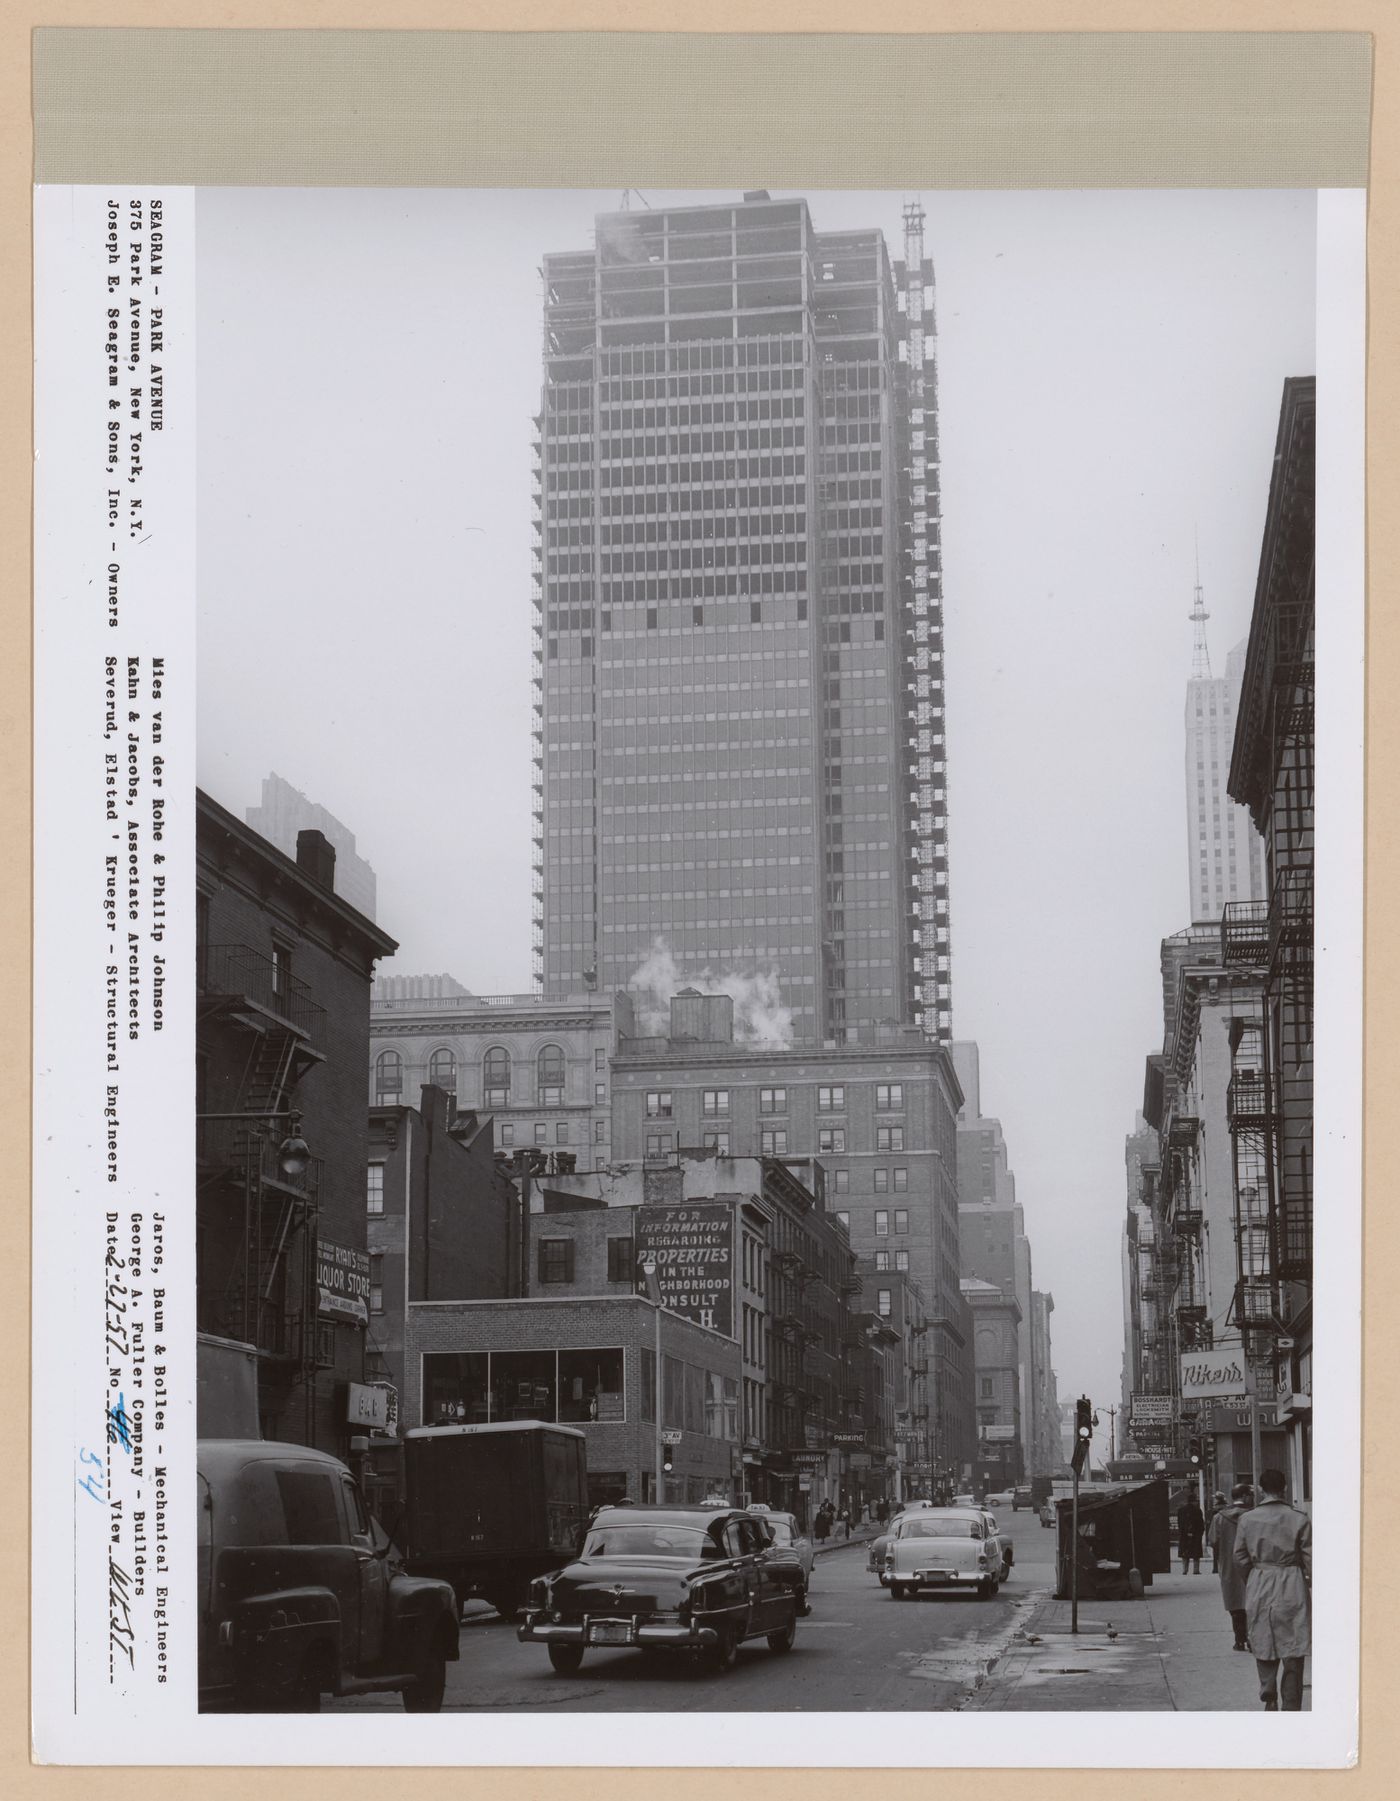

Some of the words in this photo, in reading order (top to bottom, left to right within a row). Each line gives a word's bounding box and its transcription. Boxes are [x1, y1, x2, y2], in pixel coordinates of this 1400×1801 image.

[105, 199, 121, 265] Joseph
[129, 199, 143, 231] 375
[149, 199, 164, 276] SEAGRAM
[107, 275, 121, 294] E.
[129, 242, 143, 287] Park
[104, 308, 120, 387] Seagram
[127, 297, 142, 372] Avenue,
[150, 308, 164, 353] PARK
[108, 398, 121, 410] &
[130, 387, 142, 420] New
[150, 363, 164, 432] AVENUE
[105, 421, 121, 473] Sons,
[127, 431, 143, 484] York,
[108, 489, 121, 528] Inc.
[130, 499, 143, 539] N.Y.
[107, 563, 121, 628] Owners
[103, 656, 118, 740] Severud,
[127, 656, 140, 700] Kahn
[151, 657, 165, 700] Mies
[128, 710, 141, 723] &
[152, 711, 162, 745] van
[105, 753, 119, 821] Elstad
[125, 732, 141, 806] Jacobs,
[152, 755, 165, 788] der
[152, 798, 165, 842] Rohe
[127, 820, 140, 921] Associate
[153, 853, 166, 865] &
[102, 855, 118, 932] Krueger
[149, 875, 166, 942] Philip
[127, 932, 141, 1041] Architects
[152, 954, 166, 1032] Johnson
[105, 965, 120, 1073] Structural
[103, 1085, 120, 1183] Engineers
[106, 1212, 119, 1255] Date
[640, 1222, 729, 1233] INFORMATION
[666, 1211, 701, 1221] FOR
[128, 1212, 143, 1278] George
[150, 1212, 165, 1274] Jaros,
[637, 1248, 729, 1264] PROPERTIES
[647, 1235, 721, 1246] REGARDING
[316, 1263, 345, 1291] LIQUOR
[347, 1272, 370, 1298] STORE
[638, 1279, 730, 1291] NGHBORHOOD
[662, 1266, 676, 1277] IN
[679, 1266, 705, 1277] THE
[130, 1288, 144, 1308] A.
[153, 1287, 166, 1333] Baum
[660, 1294, 719, 1307] ONSULT
[131, 1321, 145, 1389] Fuller
[154, 1344, 167, 1356] &
[109, 1367, 121, 1388] No
[153, 1365, 168, 1431] Bolles
[130, 1399, 145, 1478] Company
[833, 1434, 864, 1442] PARKING
[110, 1500, 123, 1544] View
[154, 1466, 169, 1574] Mechanical
[133, 1510, 147, 1596] Builders
[153, 1586, 170, 1684] Engineers
